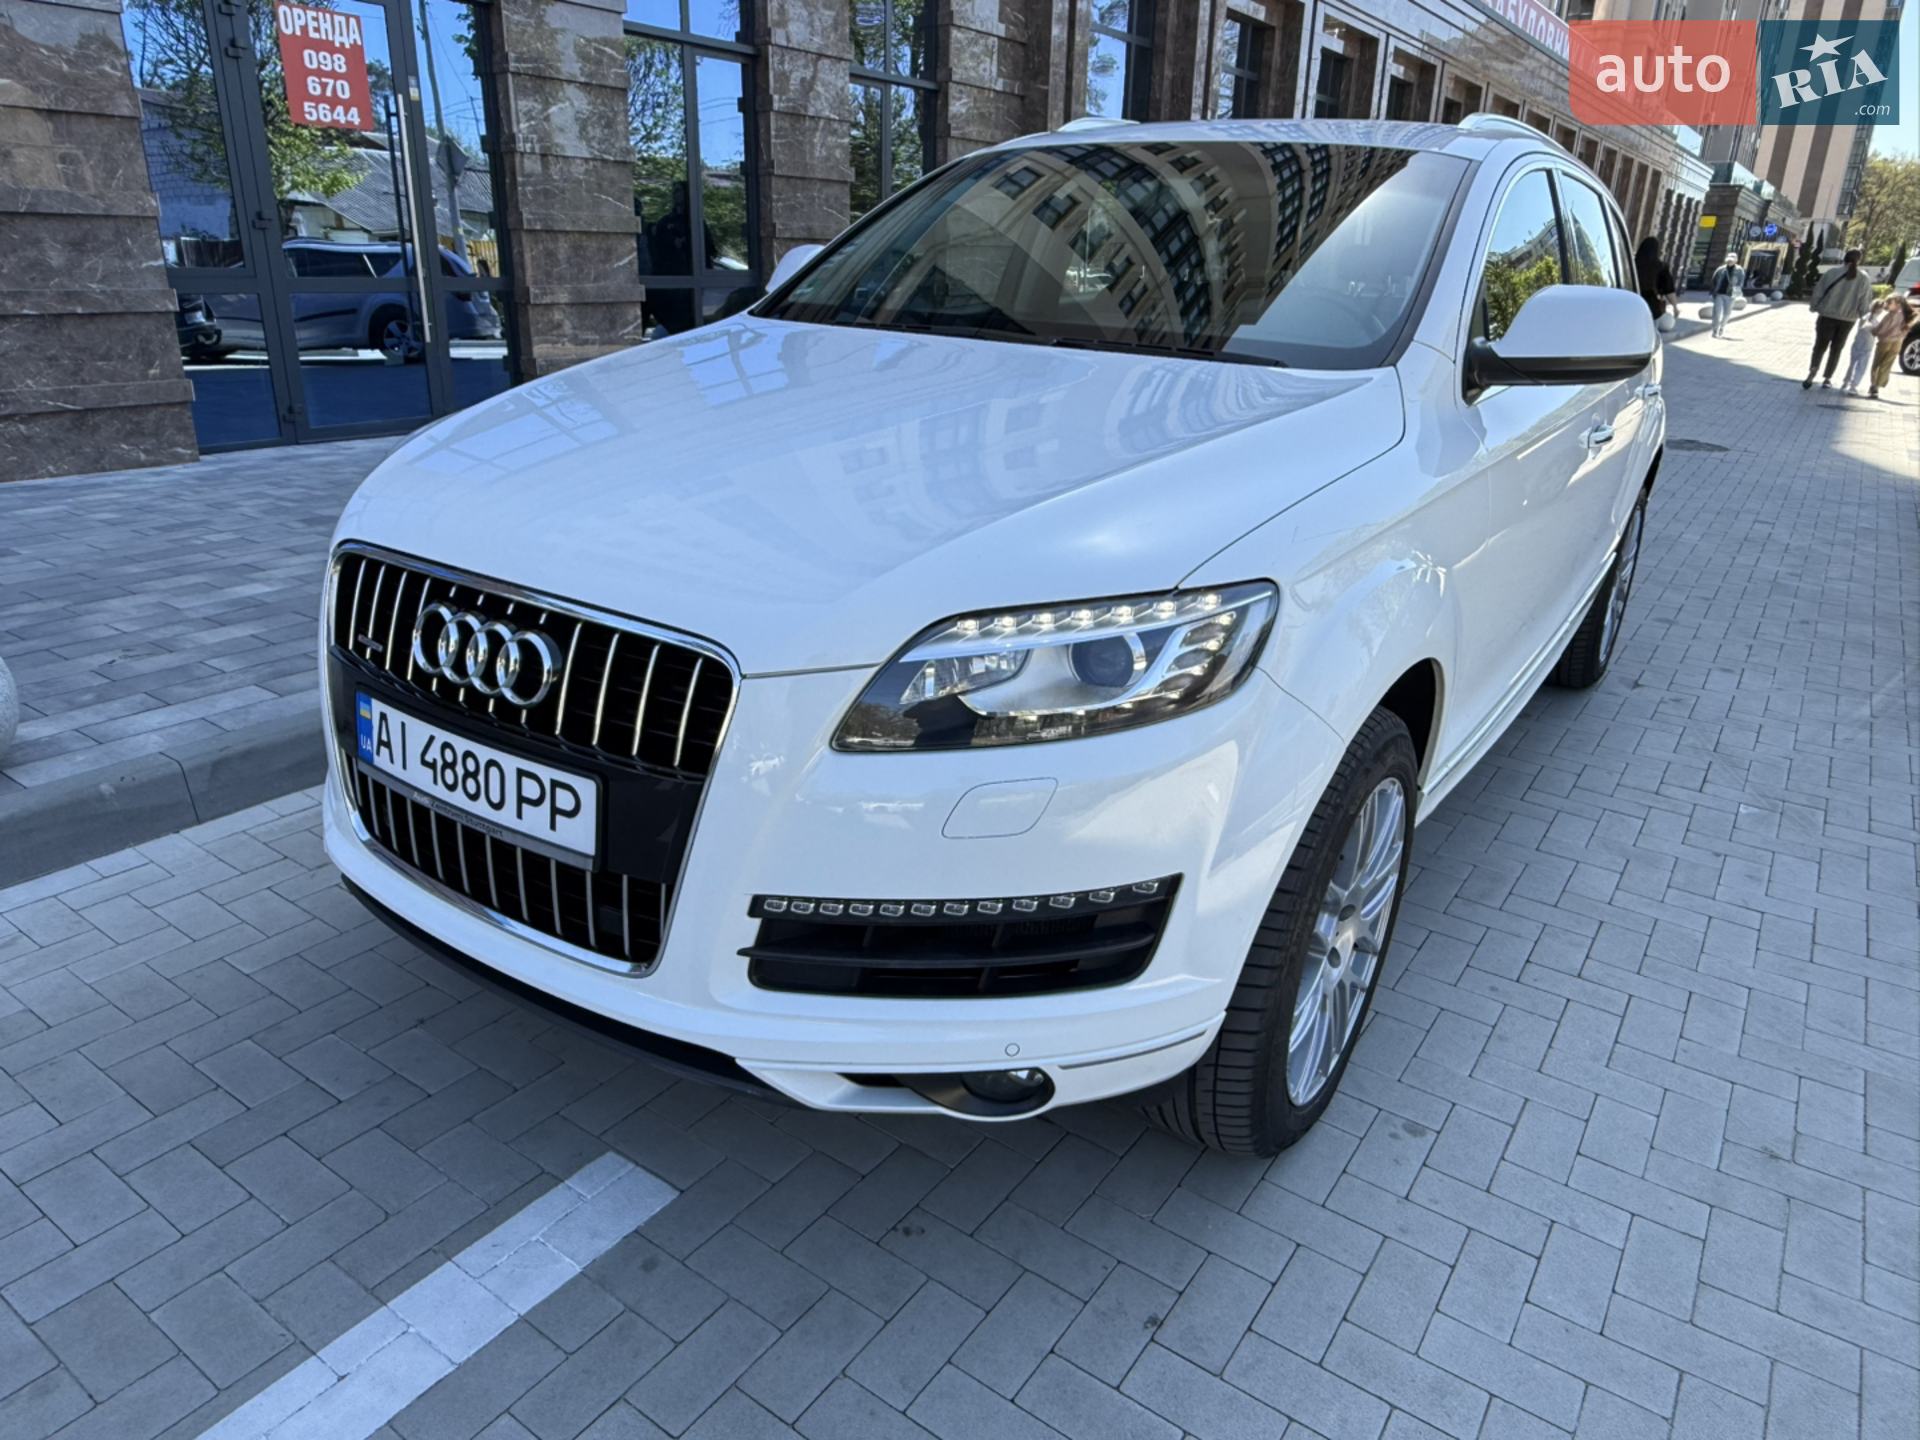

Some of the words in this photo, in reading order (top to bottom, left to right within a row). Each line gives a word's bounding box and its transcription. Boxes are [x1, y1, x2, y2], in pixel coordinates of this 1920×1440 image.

[278, 4, 362, 48] ОРЕНДА
[303, 49, 347, 73] 098
[306, 76, 350, 99] 670
[303, 101, 361, 125] 5644
[360, 734, 373, 754] UA
[376, 711, 407, 771] AI
[420, 734, 506, 811] 4880
[516, 767, 582, 832] PP
